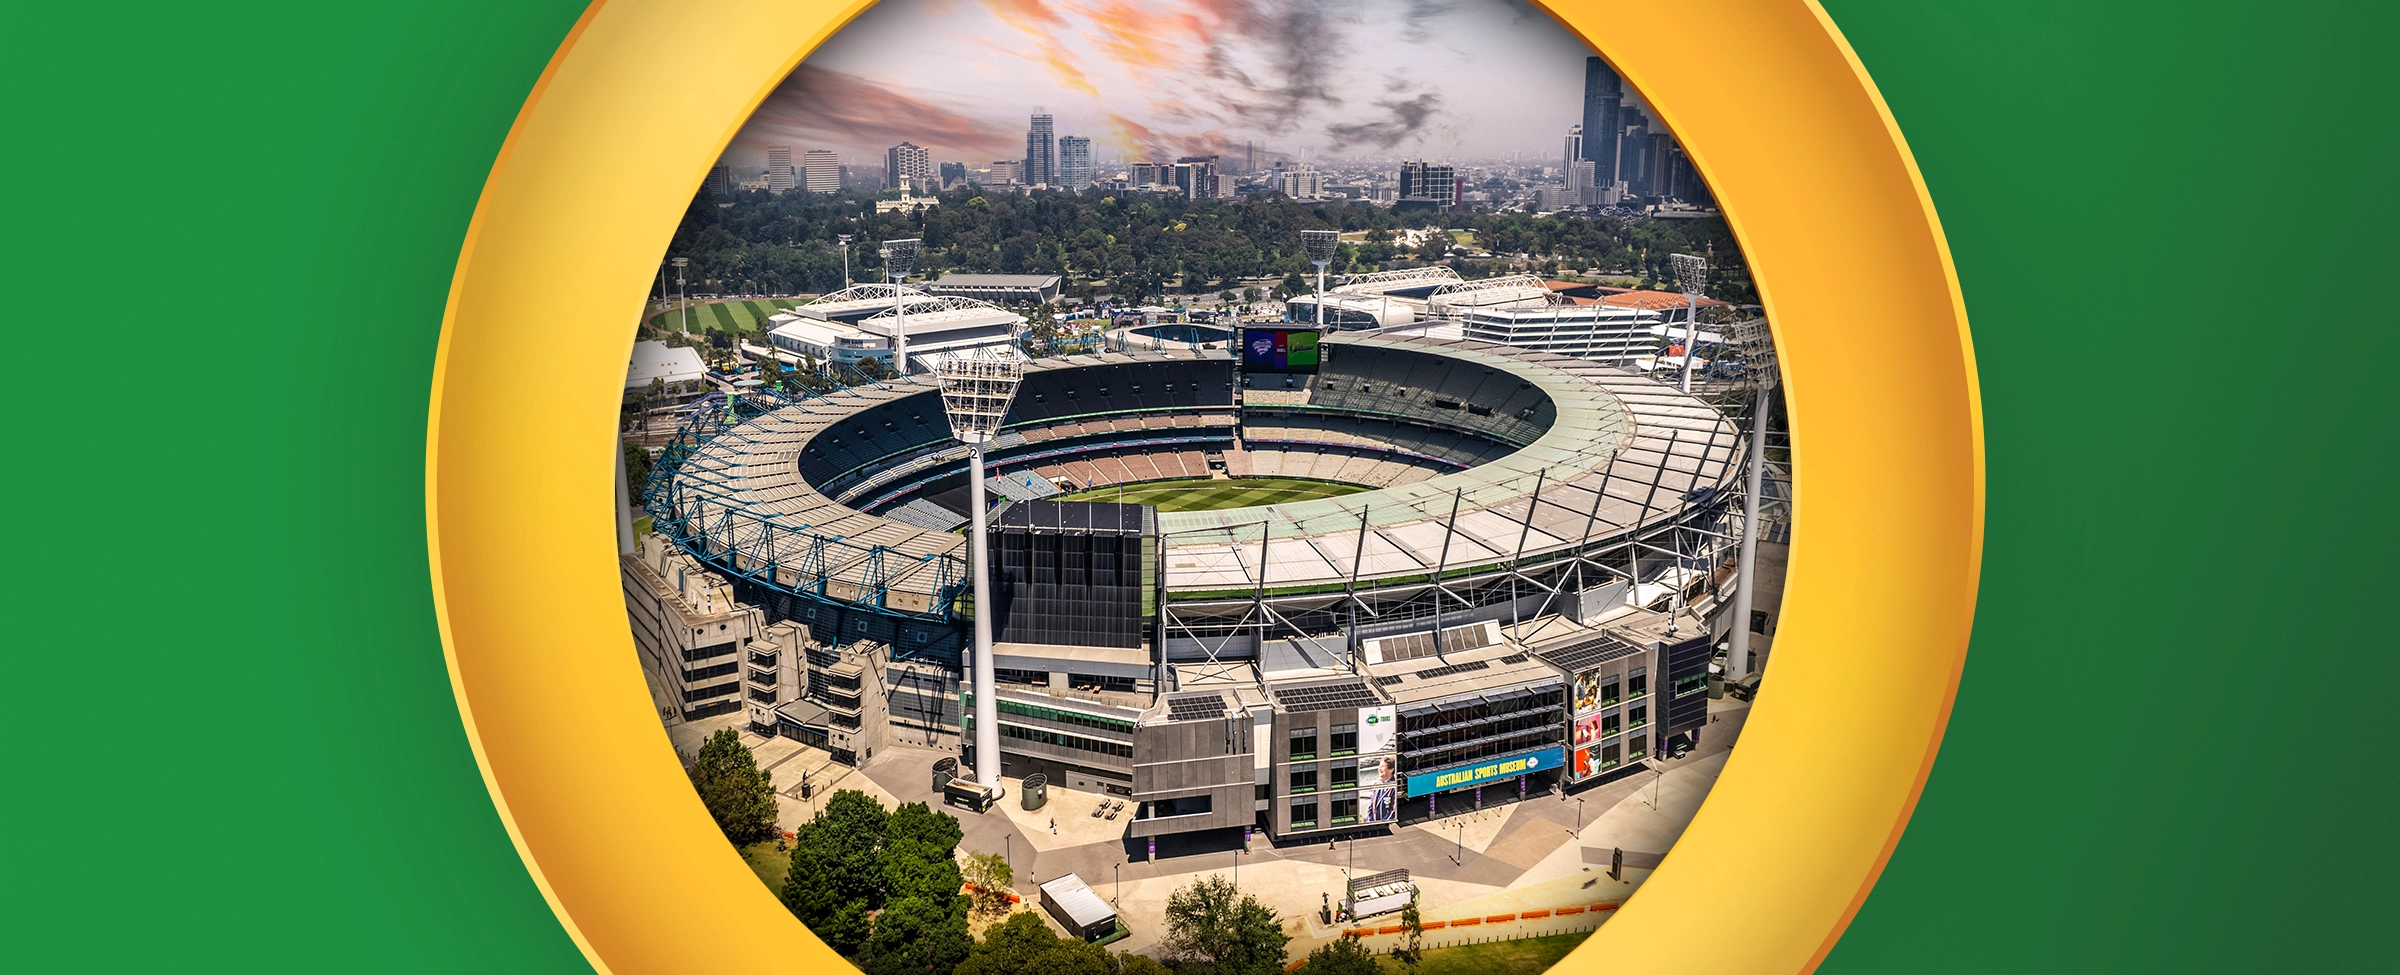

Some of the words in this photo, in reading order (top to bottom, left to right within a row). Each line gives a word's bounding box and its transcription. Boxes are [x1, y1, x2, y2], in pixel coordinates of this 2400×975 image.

[970, 448, 978, 459] 2
[1436, 770, 1473, 788] AUSTRALIAN
[1474, 764, 1498, 780] SPORTS
[1499, 758, 1527, 775] MUSEUM
